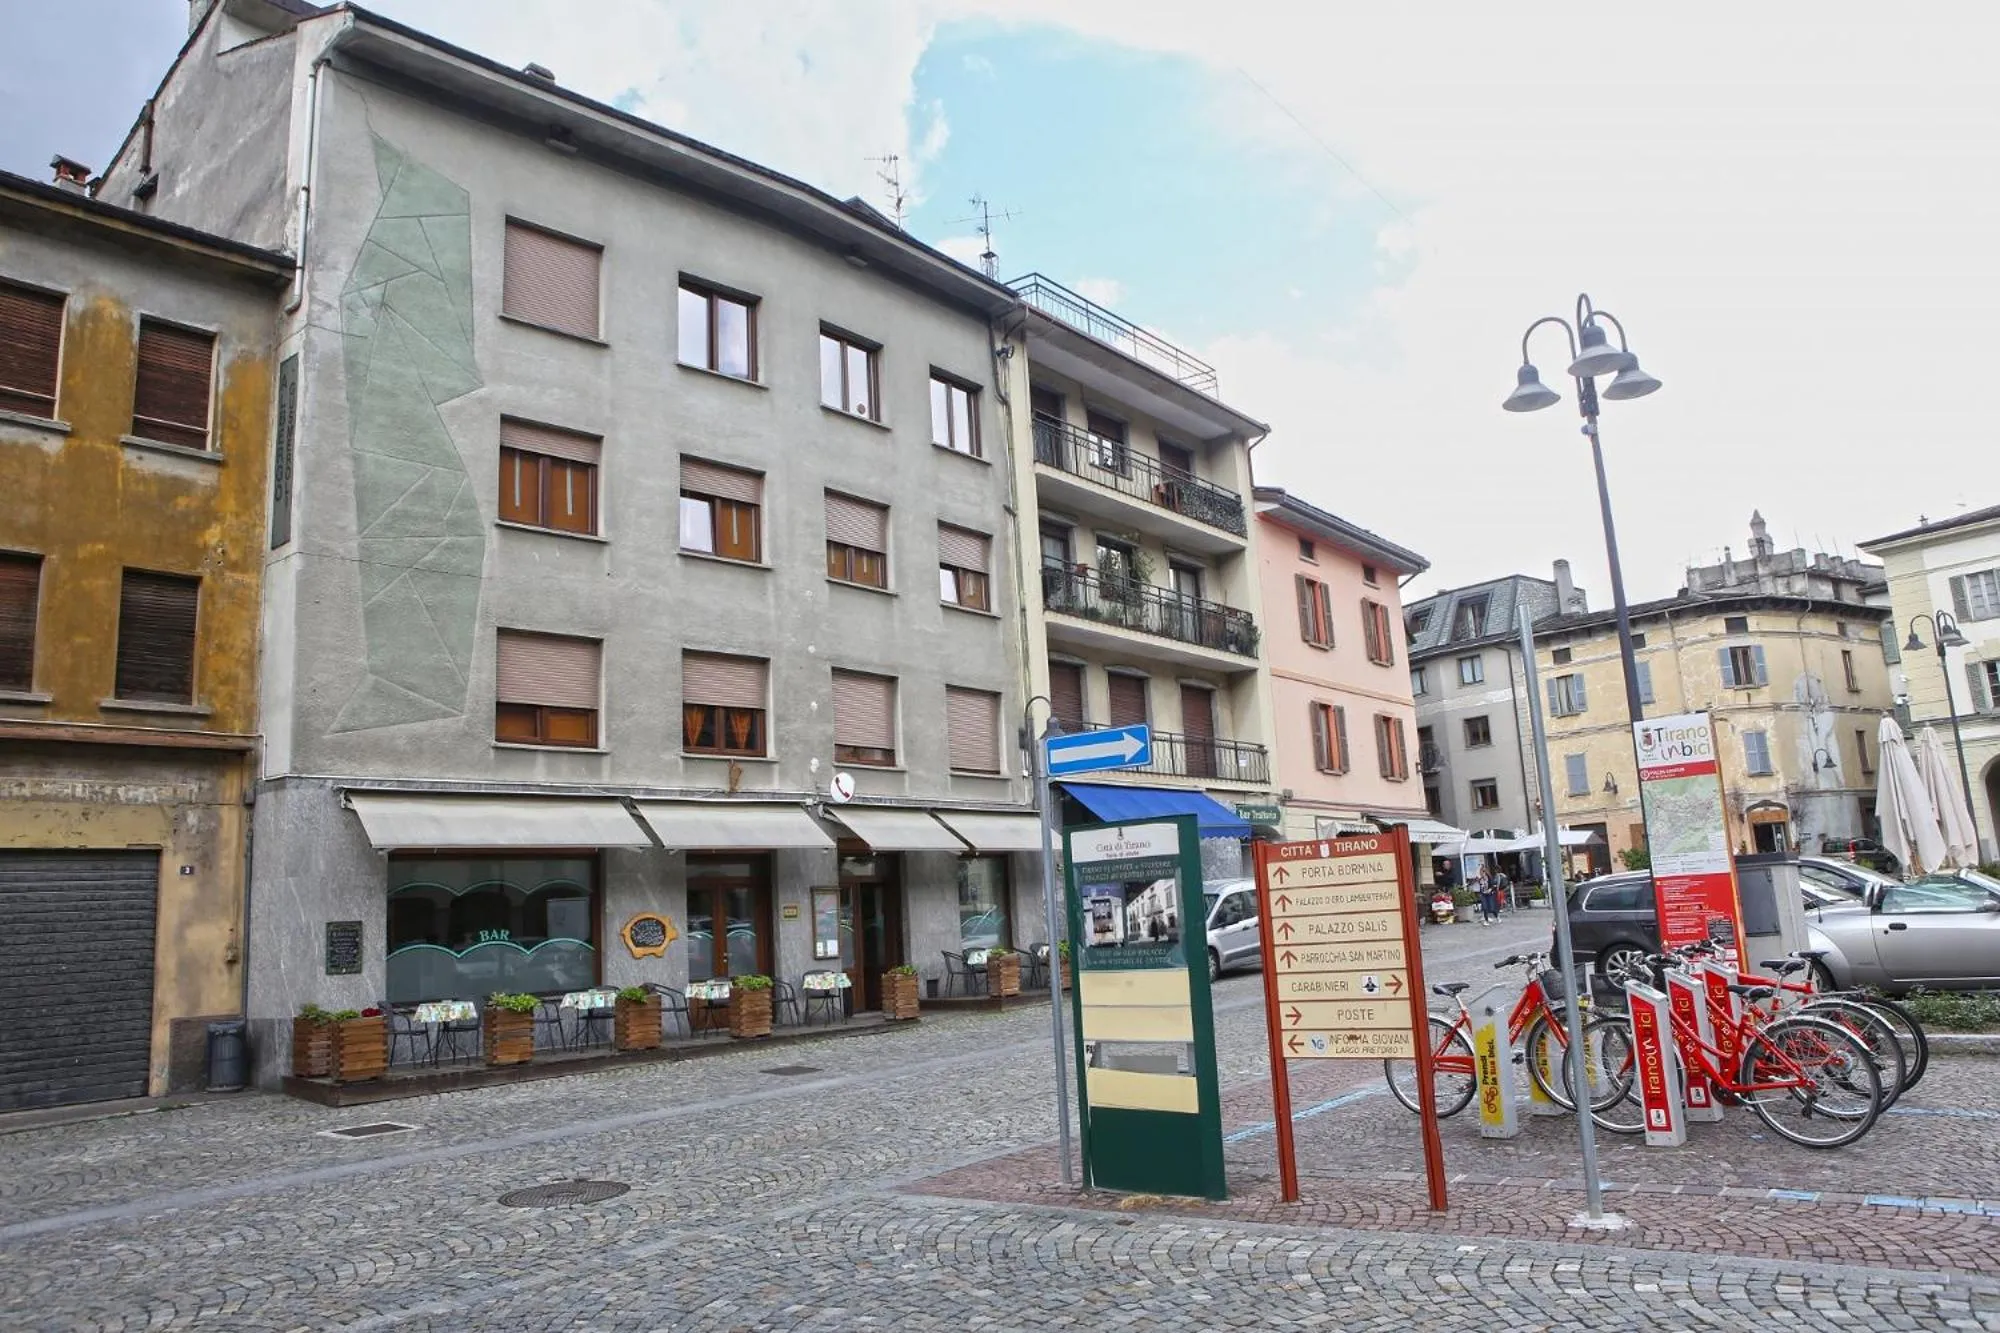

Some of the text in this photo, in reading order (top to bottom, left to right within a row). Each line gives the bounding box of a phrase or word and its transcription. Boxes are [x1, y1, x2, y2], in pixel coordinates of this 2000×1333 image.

[1653, 727, 1708, 743] Tirano
[1124, 840, 1151, 850] Tirano
[1334, 838, 1379, 854] TIRANO
[1302, 861, 1384, 879] PORTA BORMINA
[1295, 894, 1323, 906] PALAZZO
[1308, 920, 1389, 935] PALAZZO SALIS
[479, 928, 511, 942] BAR
[1300, 949, 1401, 965] PARROCCHIA SAN MARTINO
[1291, 980, 1350, 993] CARABINIERI
[1336, 1008, 1375, 1021] POSTE
[1371, 1033, 1410, 1045] GIOVANI
[1479, 1055, 1490, 1086] Prendi
